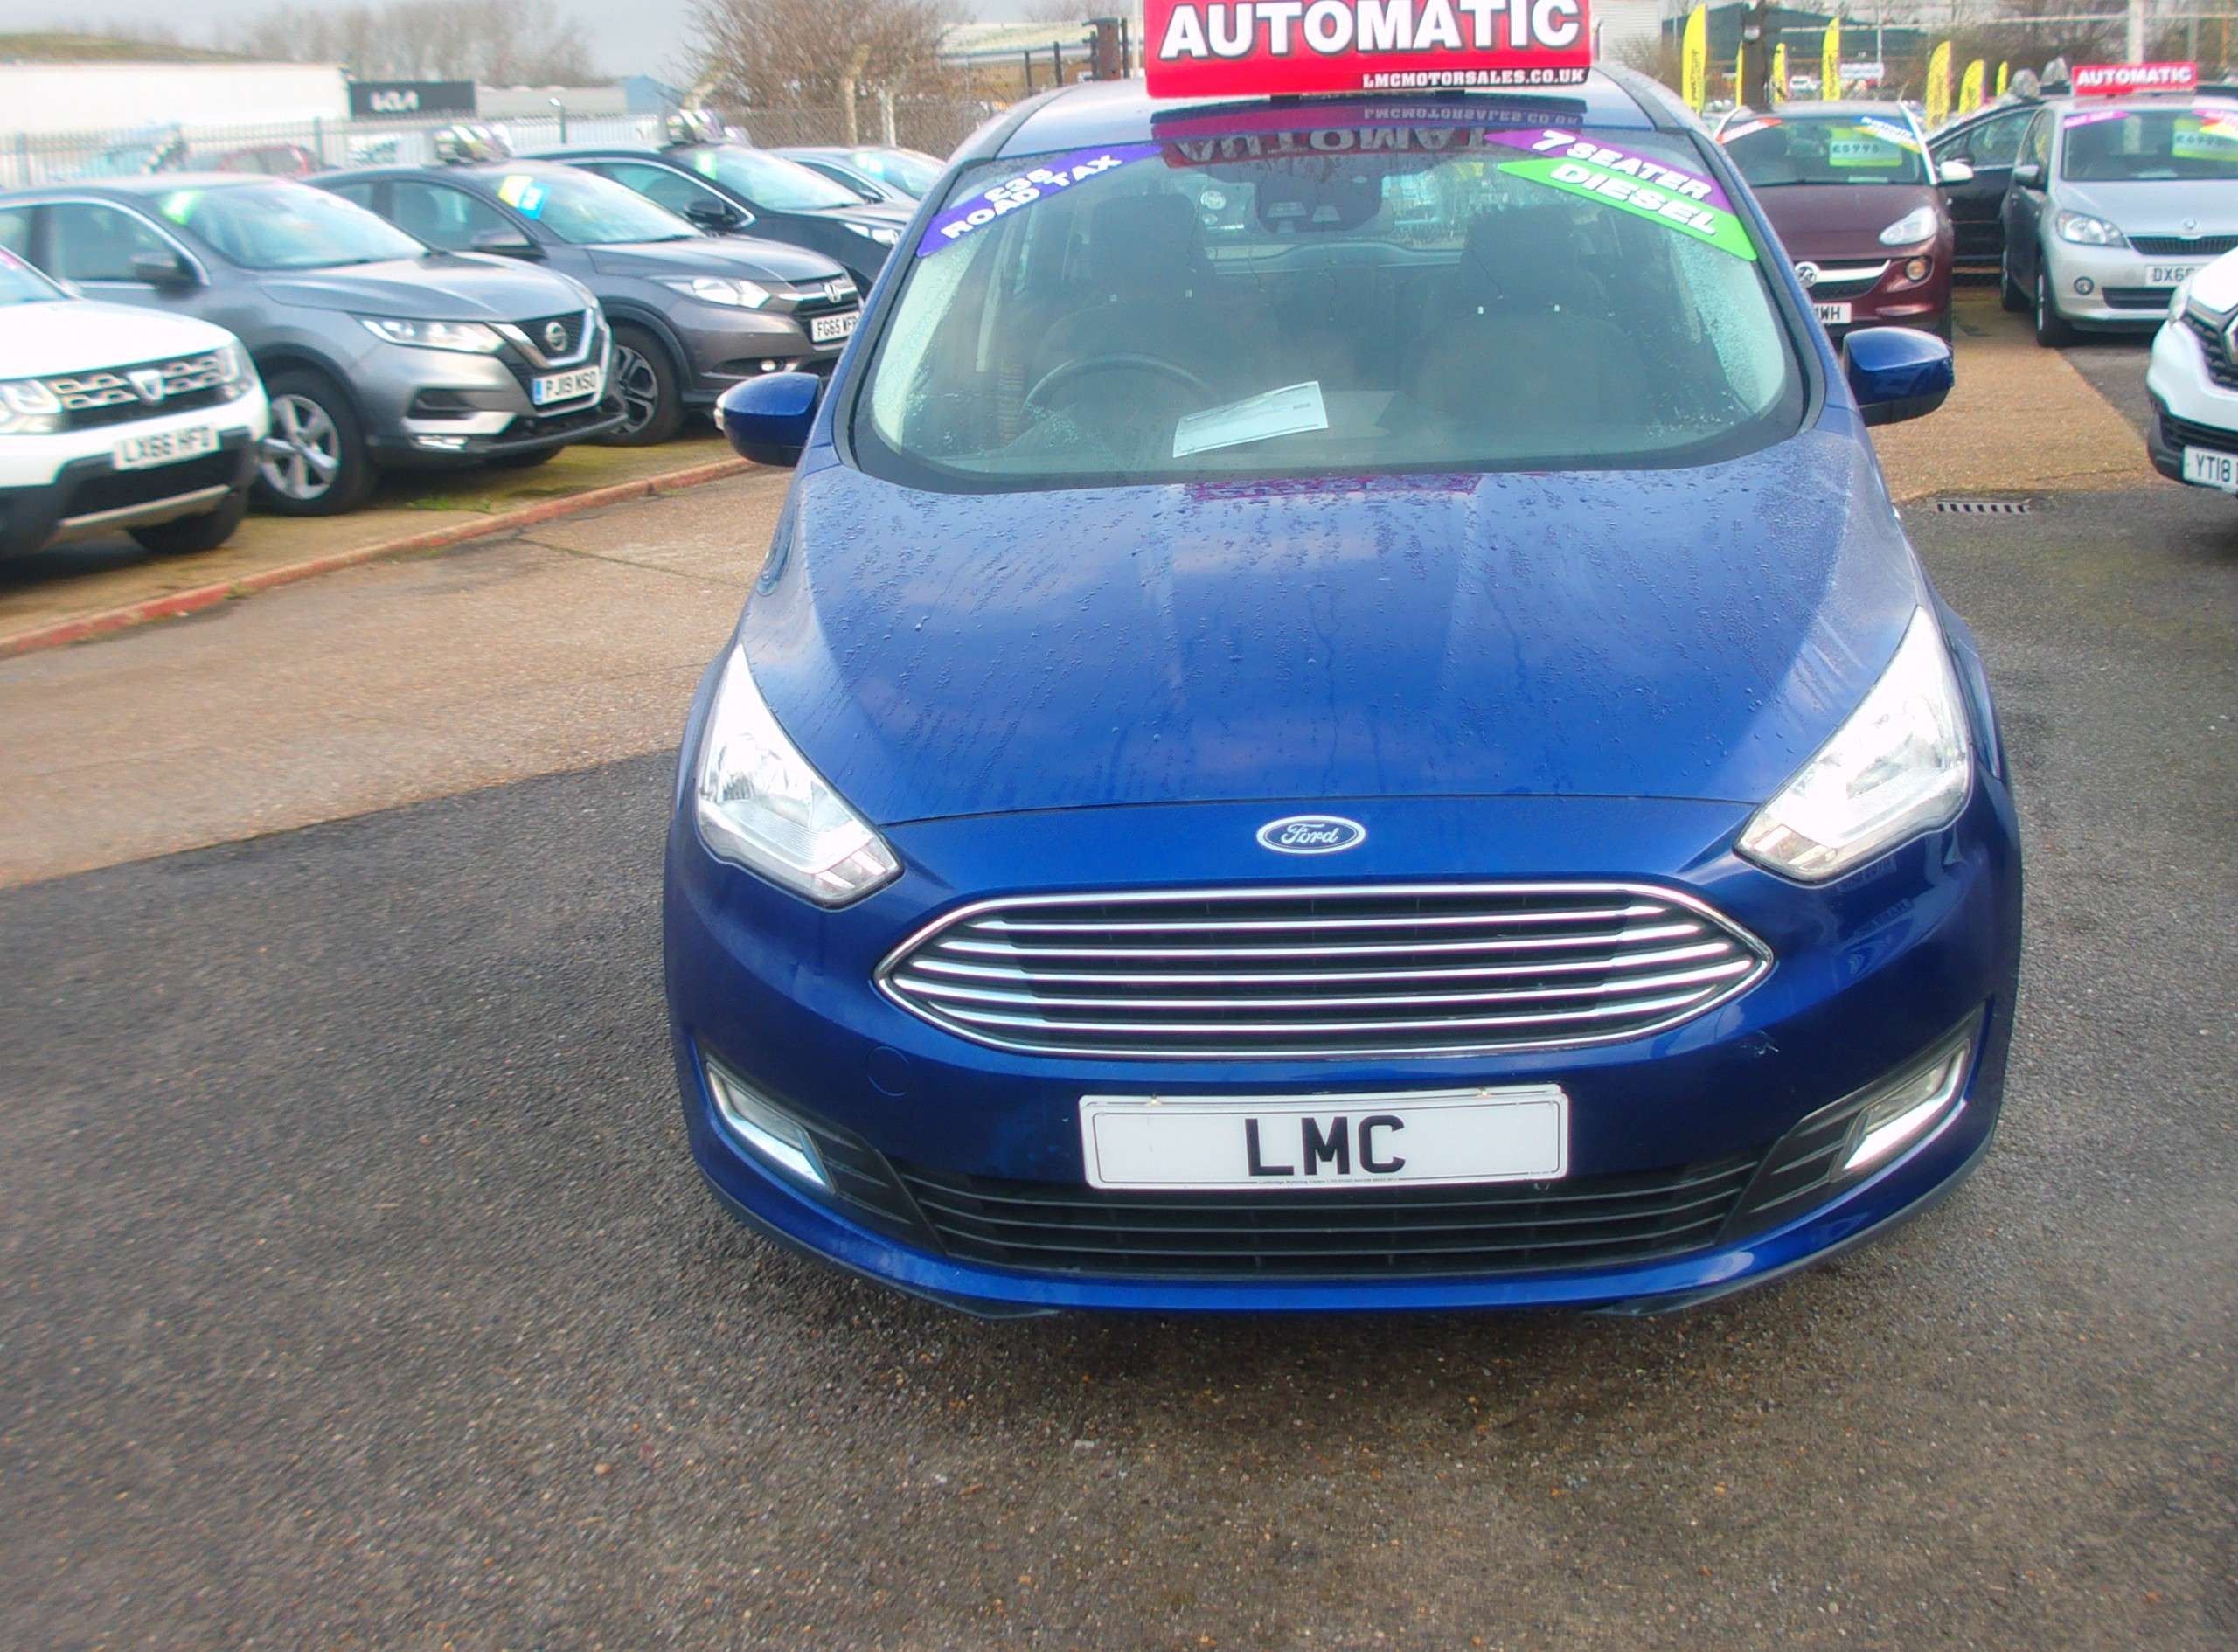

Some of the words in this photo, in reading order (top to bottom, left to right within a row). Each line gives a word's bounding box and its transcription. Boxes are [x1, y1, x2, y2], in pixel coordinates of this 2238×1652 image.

[1160, 0, 1580, 59] AUTOMATIC
[1362, 68, 1586, 88] LMCMOTORSALES.CO.UK
[2077, 66, 2193, 85] AUTOMATIC
[1533, 130, 1576, 151] 7
[1567, 142, 1712, 200] SEATER
[941, 187, 1040, 239] ROAD
[1044, 155, 1122, 187] TAX
[984, 169, 1053, 203] £35
[1550, 163, 1716, 234] DIESEL
[817, 318, 840, 337] FG65
[1816, 306, 1840, 321] WH
[546, 376, 573, 399] PJ19
[2195, 454, 2231, 482] YT18
[1281, 823, 1339, 844] Ford
[1245, 1115, 1406, 1177] LMC
